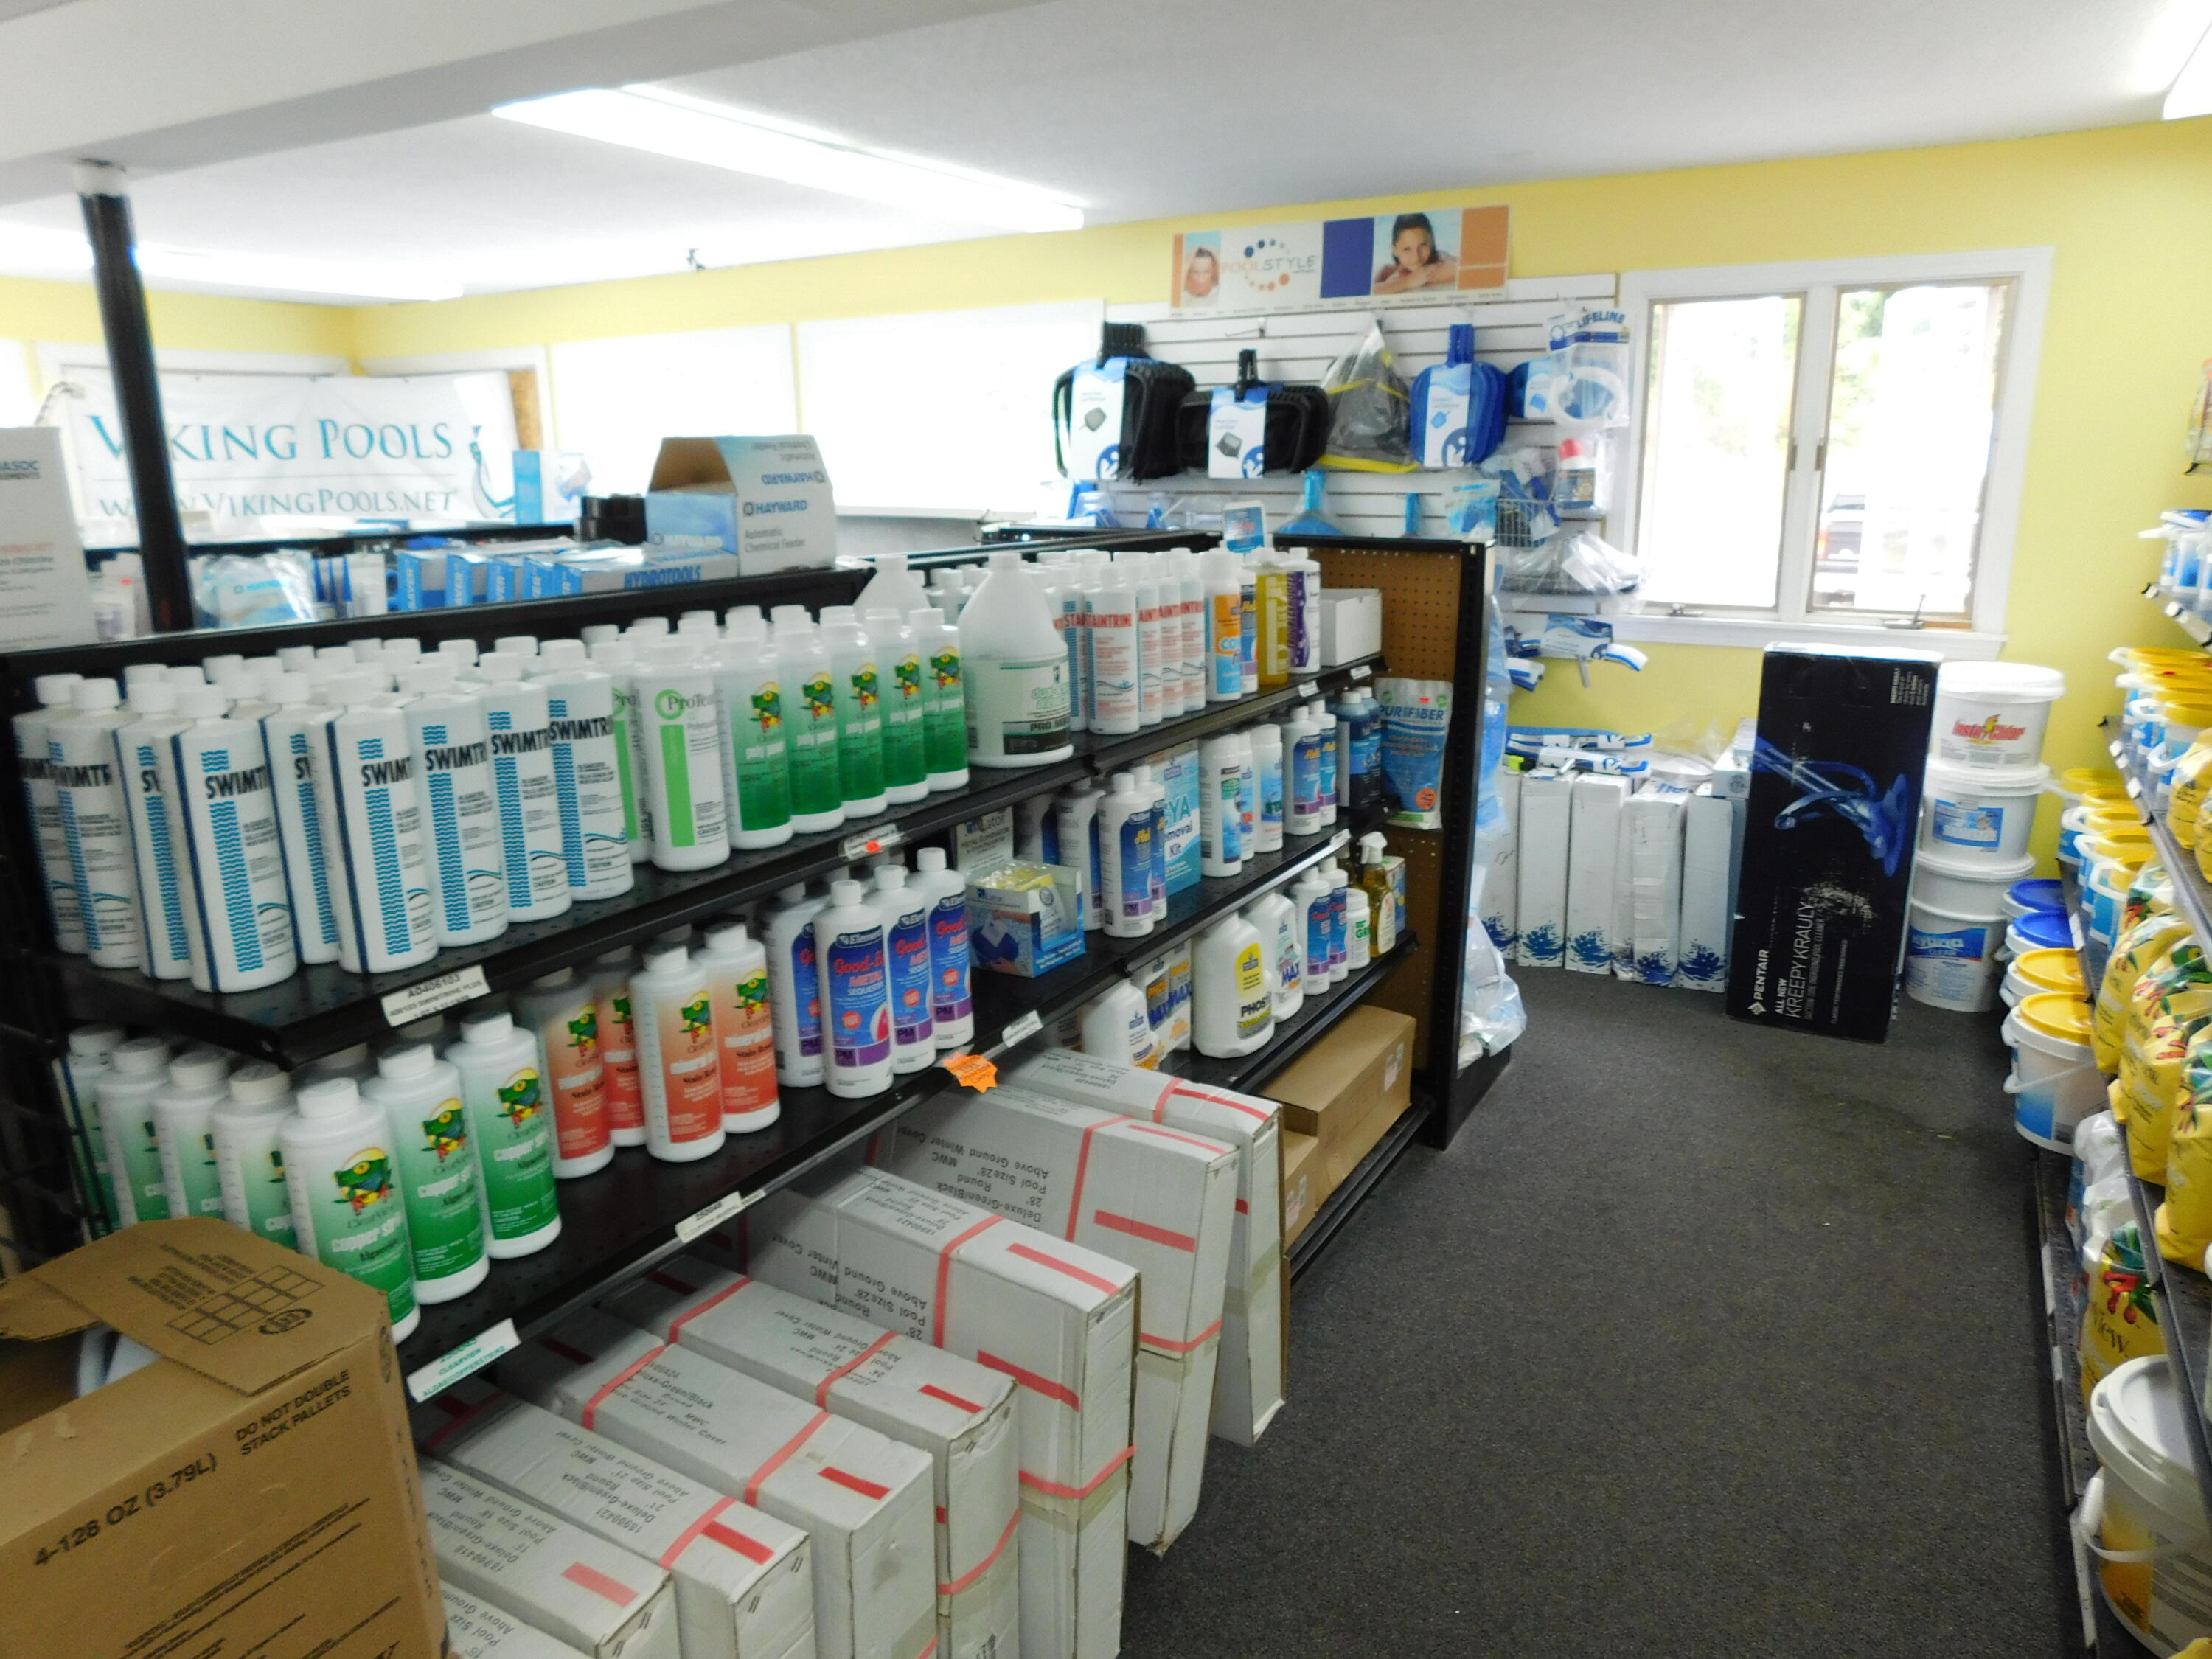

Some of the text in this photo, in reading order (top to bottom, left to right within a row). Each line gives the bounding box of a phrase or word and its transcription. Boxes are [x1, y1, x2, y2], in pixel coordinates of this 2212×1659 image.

[86, 413, 453, 462] VKING POOLS
[98, 486, 456, 518] WVIKINGPOOLS.NET
[754, 499, 807, 515] HAYWARD
[1164, 820, 1193, 842] emoval
[1169, 841, 1183, 858] Kit
[1785, 900, 1815, 1019] KREEPY KRAULY
[1755, 948, 1770, 1001] PENTAIR
[1775, 977, 1788, 1015] ALL NEW
[929, 1136, 965, 1156] Winter
[931, 1151, 959, 1168] MWC
[968, 1148, 1009, 1169] Ground
[1014, 1161, 1050, 1180] Above
[956, 1174, 992, 1192] Round
[1020, 1179, 1047, 1194] Pool
[844, 1267, 886, 1293] Ground
[890, 1287, 928, 1311] Above
[899, 1306, 926, 1327] Pool
[773, 1310, 902, 1363] Abov Ground Winter Cover
[791, 1328, 817, 1341] MWC
[234, 1369, 351, 1443] DO NOT DOUBLE
[240, 1384, 352, 1457] STACK PALLETS
[569, 1449, 597, 1465] MWC
[584, 1444, 616, 1462] Winter
[616, 1459, 655, 1481] Ground
[584, 1473, 619, 1492] Round
[630, 1477, 653, 1492] Size
[656, 1478, 689, 1498] Above
[483, 1496, 523, 1518] Ground
[651, 1489, 679, 1504] Pool
[34, 1452, 218, 1567] 4-128 OZ (3.79L)
[524, 1515, 557, 1534] Above
[594, 1507, 643, 1534] 18900421
[441, 1590, 515, 1635] Above Groun
[448, 1613, 502, 1647] Pool Size
